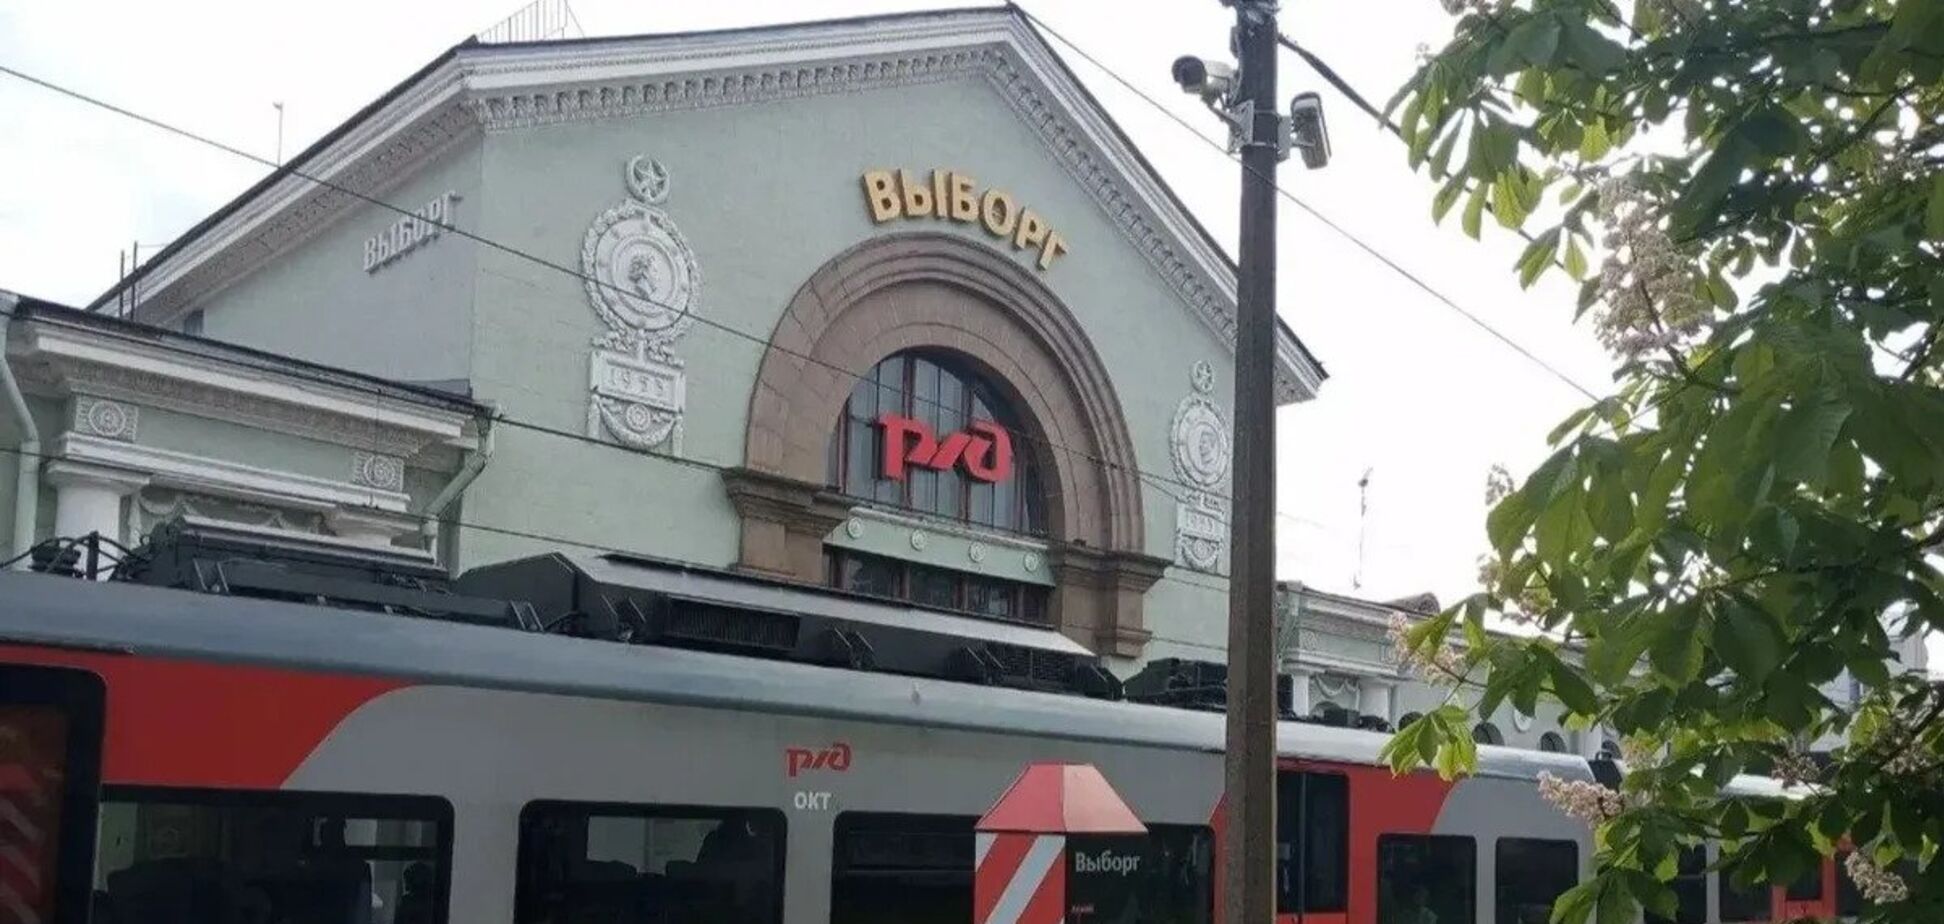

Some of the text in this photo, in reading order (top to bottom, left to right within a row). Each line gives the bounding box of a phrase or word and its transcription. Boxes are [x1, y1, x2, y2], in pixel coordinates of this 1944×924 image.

[364, 190, 457, 271] ВЫБОРГ
[862, 168, 1069, 271] ВЫБОРГ
[794, 791, 831, 810] ОКТ
[1075, 850, 1140, 877] Выборг
